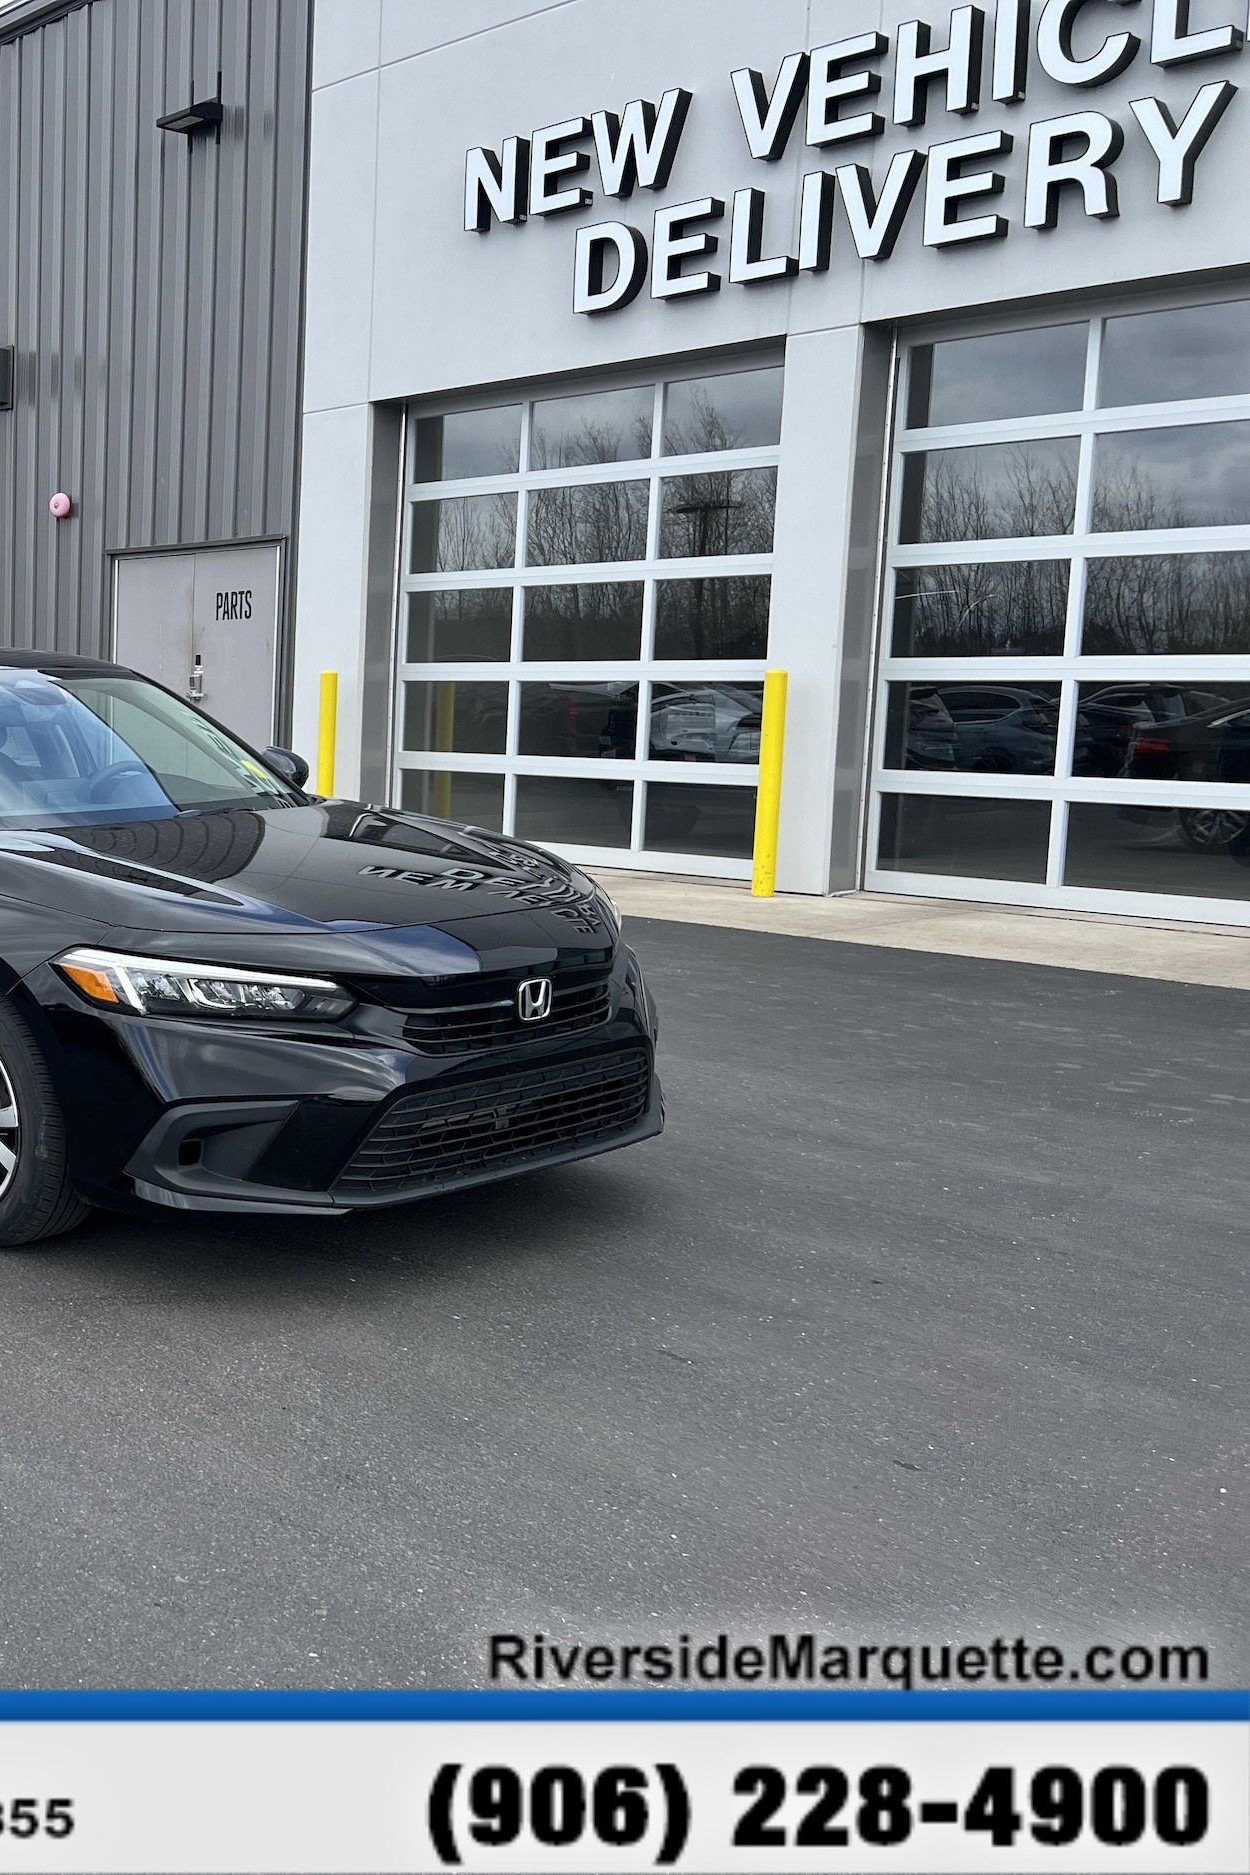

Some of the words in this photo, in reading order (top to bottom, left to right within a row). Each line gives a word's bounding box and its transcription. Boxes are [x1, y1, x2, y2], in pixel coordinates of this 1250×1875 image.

[464, 88, 693, 232] NEW
[731, 0, 1250, 162] VEHICL
[572, 80, 1238, 316] DELIVERY
[215, 589, 253, 621] PARTS
